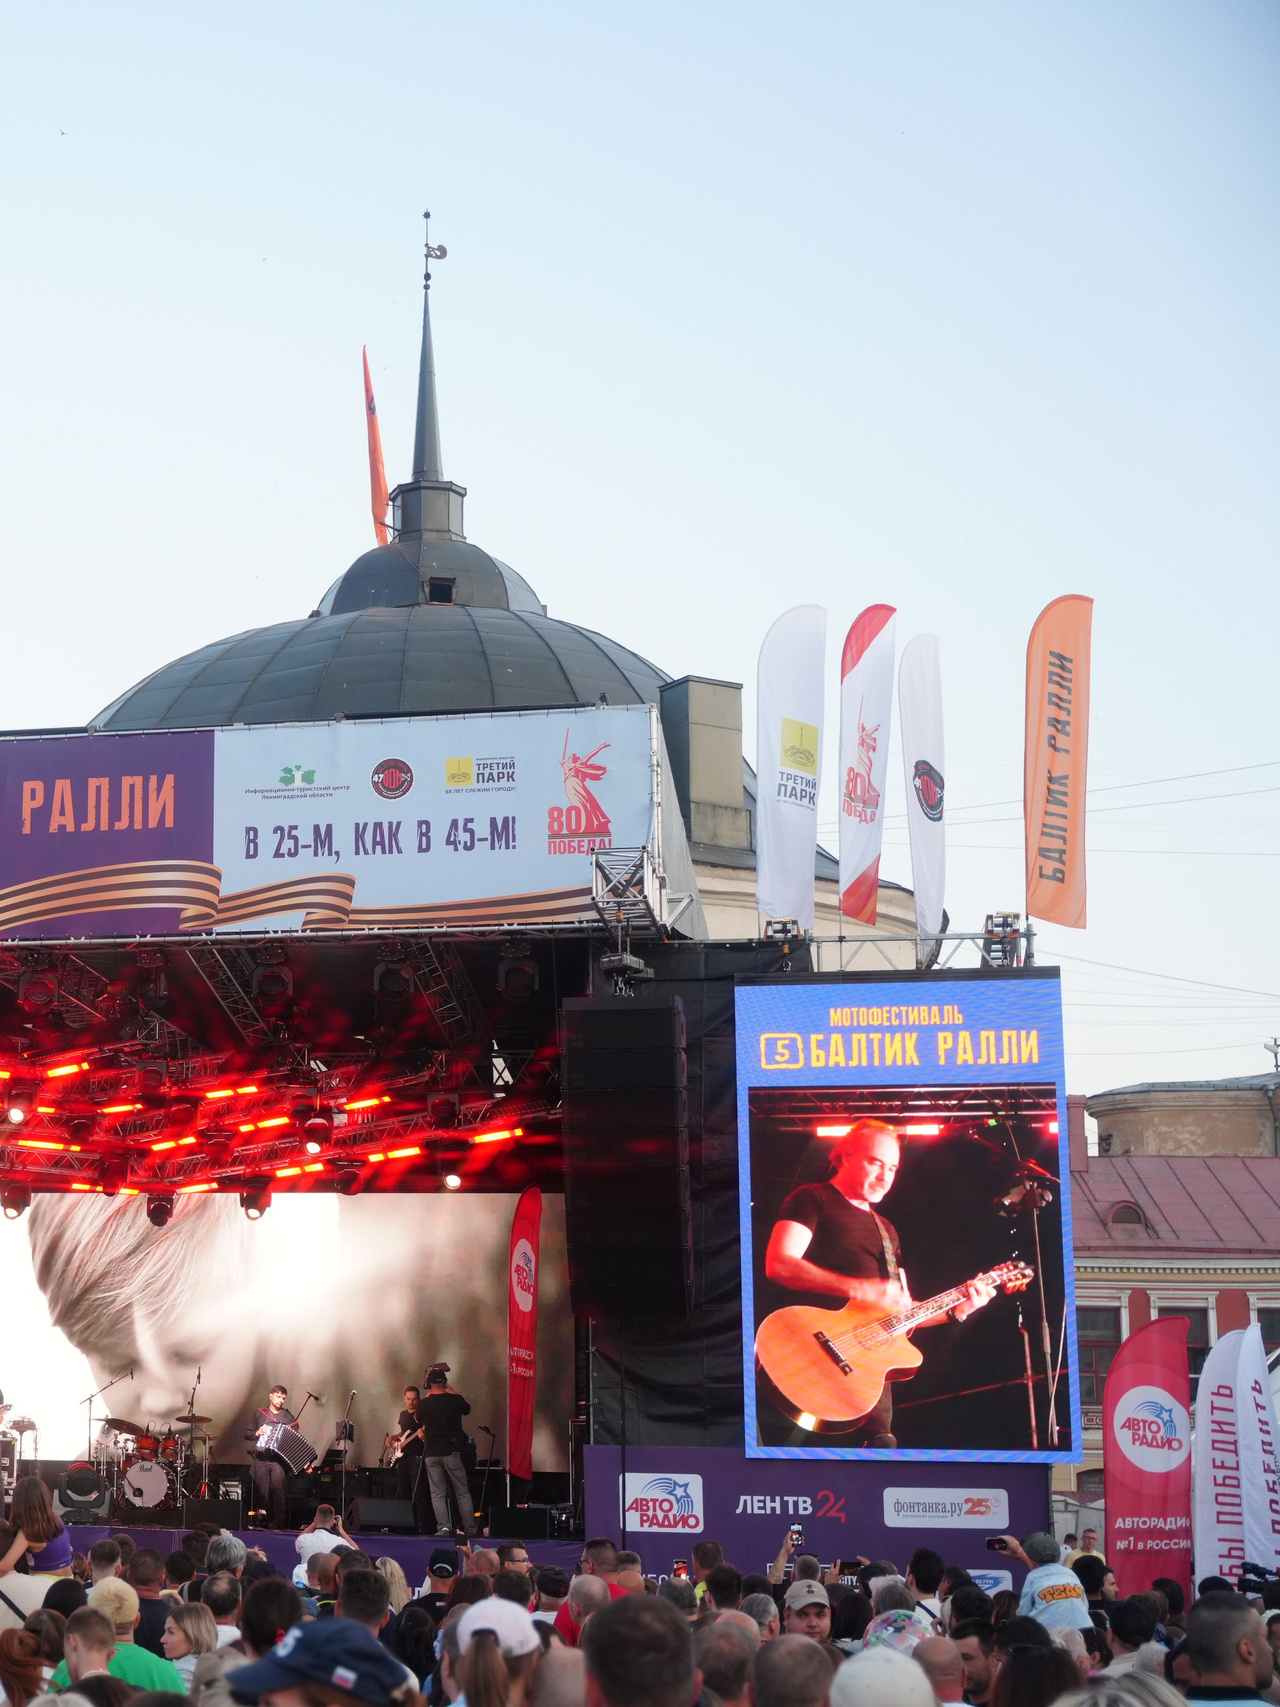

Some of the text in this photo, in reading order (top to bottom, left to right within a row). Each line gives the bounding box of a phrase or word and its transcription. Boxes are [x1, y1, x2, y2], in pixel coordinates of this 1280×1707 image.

[1047, 650, 1074, 755] РАЛЛИ
[476, 760, 515, 771] ТРЕТИЙ
[477, 771, 515, 783] ПАРК
[779, 771, 817, 791] ТРЕТИЙ
[845, 766, 866, 798] 80
[22, 773, 175, 835] РАЛЛИ
[777, 783, 815, 806] ПАРК
[548, 805, 582, 834] 80
[245, 815, 516, 864] В 25-М, КАК В 45-М!
[830, 1006, 963, 1025] МОТОФЕСТИВАЛЬ
[775, 1030, 1039, 1067] 5 БАЛТИК РАЛЛИ
[1119, 1416, 1161, 1434] АВТО
[1131, 1430, 1183, 1452] РАДИО
[1210, 1384, 1243, 1526] ПОБЕДИТЬ
[624, 1497, 674, 1513] АВТО
[815, 1489, 846, 1523] 24
[893, 1497, 992, 1517] фонтанка.ру 25
[639, 1513, 700, 1529] РАДИО
[1116, 1536, 1134, 1550] №1
